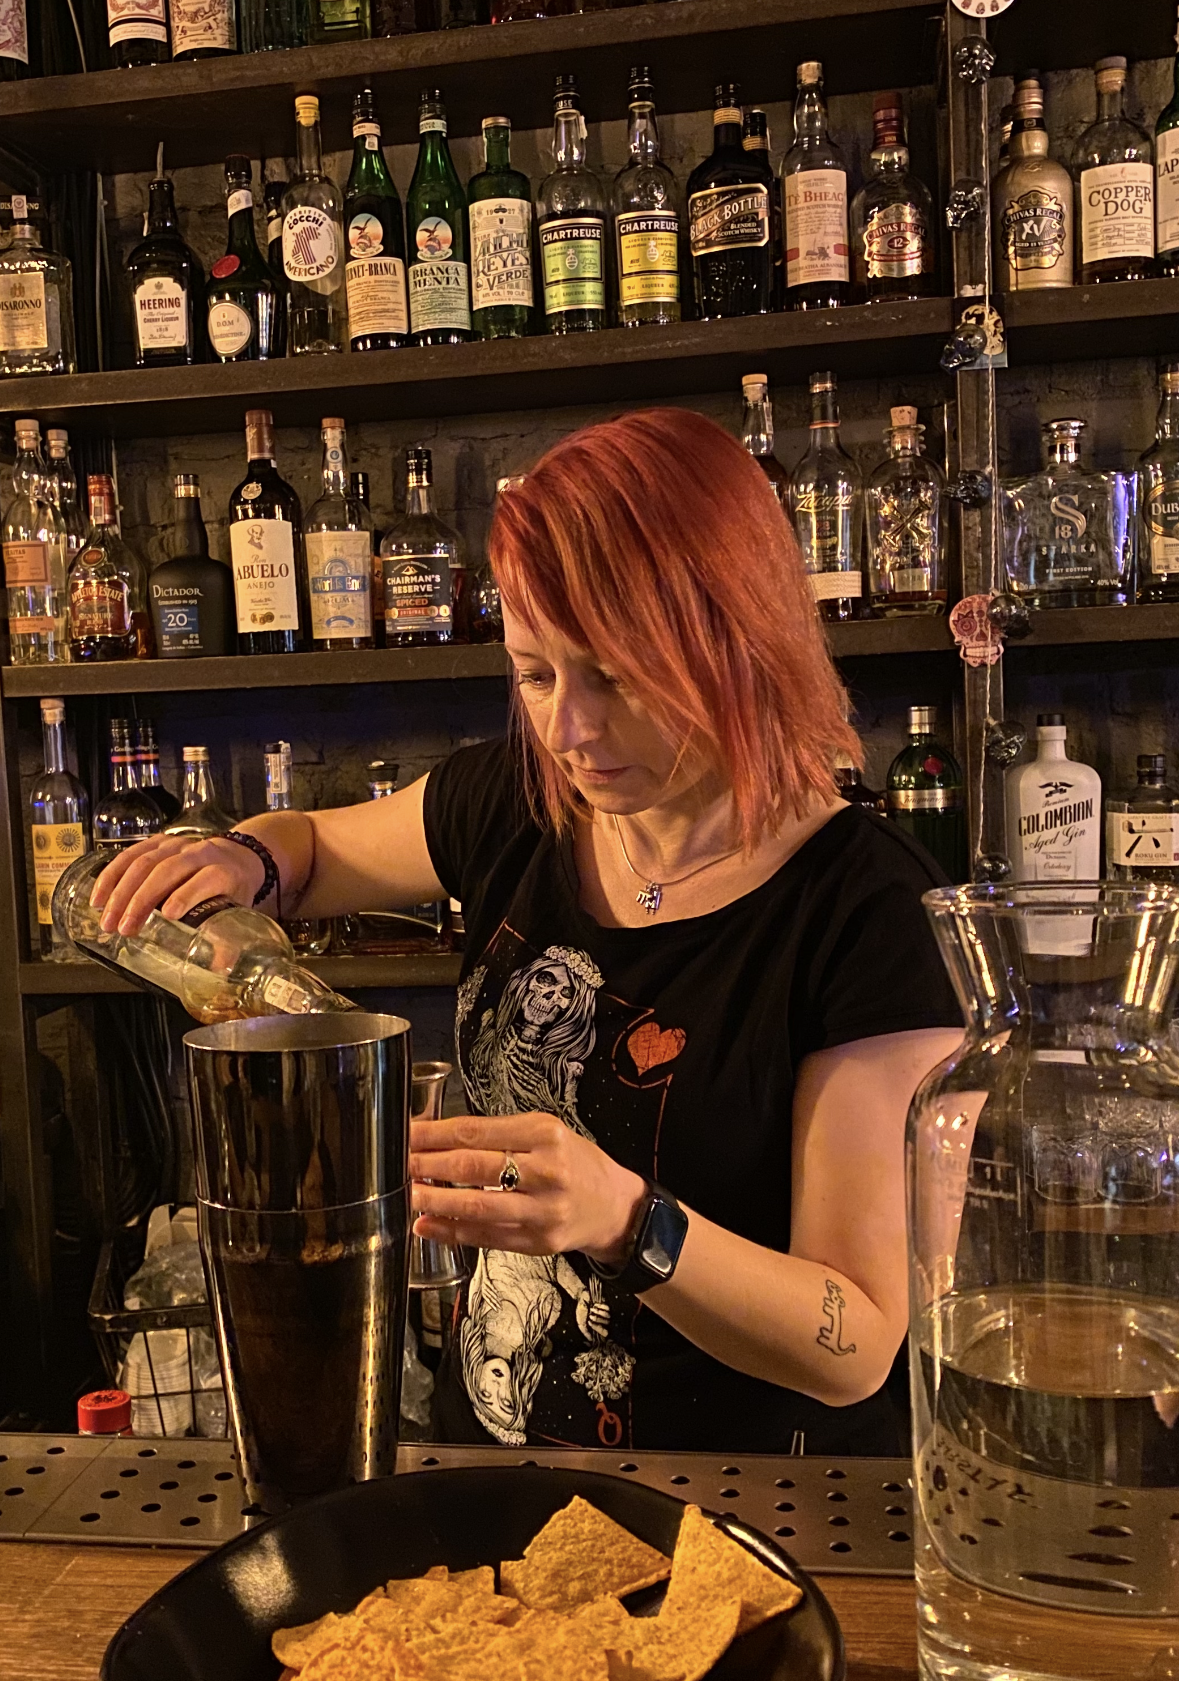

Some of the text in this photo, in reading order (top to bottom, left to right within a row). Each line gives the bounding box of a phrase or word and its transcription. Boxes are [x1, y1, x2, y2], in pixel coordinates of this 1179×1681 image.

[1088, 185, 1151, 207] COPPER
[1103, 198, 1144, 217] DOG
[288, 215, 324, 230] COCCHI
[690, 210, 722, 240] BLACK
[722, 196, 767, 220] BOTTLE
[1005, 208, 1061, 225] CHIVAS REGAL
[620, 220, 679, 234] CHARTREUSE
[718, 229, 740, 237] SCOTCH
[867, 222, 926, 240] CHIVAS REGAL
[1021, 218, 1047, 240] XV
[542, 228, 601, 243] CHARTREUSE
[894, 237, 904, 247] 12
[285, 255, 335, 277] AMERICANO
[346, 262, 397, 281] ERNET-BRANCA
[413, 266, 460, 280] BRANCA
[413, 277, 461, 290] MENTA
[487, 269, 529, 290] VERDE
[0, 298, 41, 311] ISARONNO
[140, 297, 181, 310] HEERING
[1041, 543, 1096, 556] STARKA
[236, 563, 289, 581] ABUELO
[387, 574, 441, 585] CHAIRMAN'S
[247, 581, 275, 590] AÑEJO
[392, 584, 433, 594] RESERVE
[99, 586, 124, 601] ESTATE
[167, 613, 188, 627] 20
[1042, 797, 1070, 808] Premium
[1018, 797, 1093, 837] COLOMBIAN
[1024, 825, 1086, 854] Aged Gin
